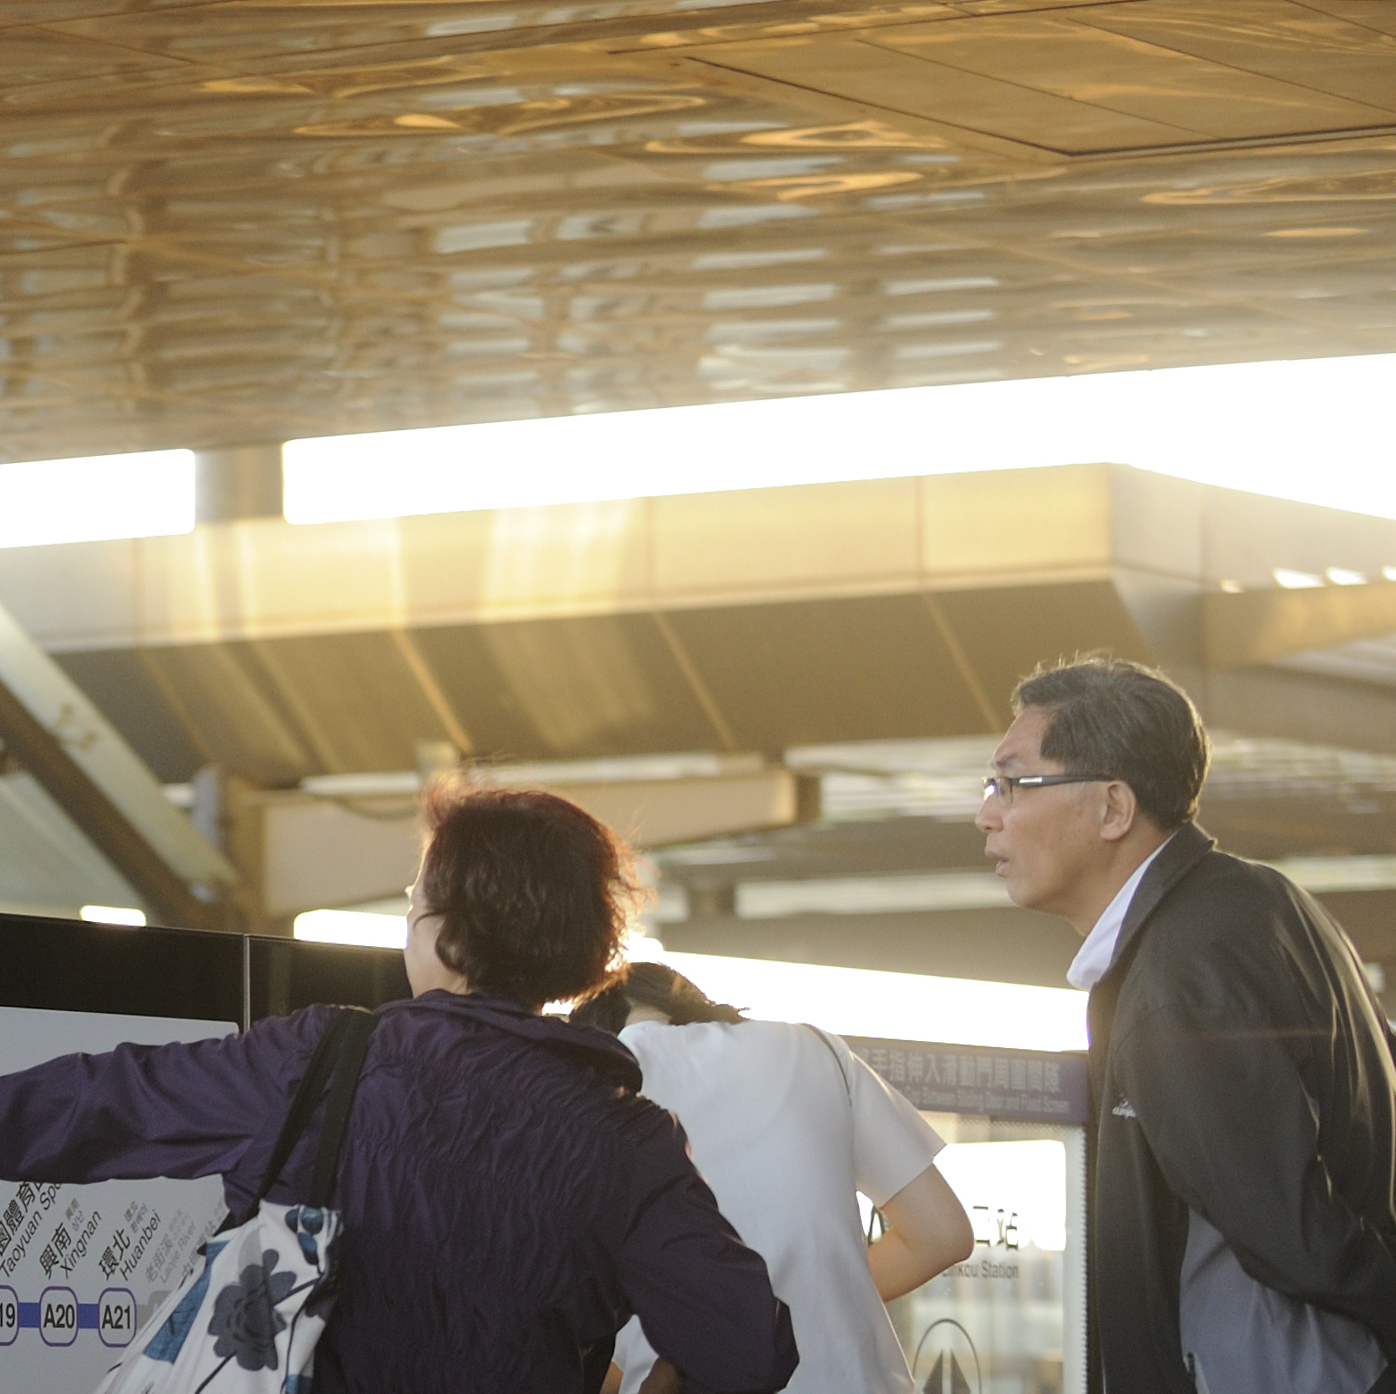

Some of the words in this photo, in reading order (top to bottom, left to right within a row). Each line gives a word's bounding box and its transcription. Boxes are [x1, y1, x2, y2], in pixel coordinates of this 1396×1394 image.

[39, 1222, 72, 1280] 興南
[60, 1210, 102, 1280] Xingnan
[98, 1229, 132, 1281] 環北
[118, 1208, 162, 1282] Huanbei
[982, 1260, 1019, 1278] Station
[43, 1303, 75, 1329] A20
[102, 1304, 131, 1329] A21
